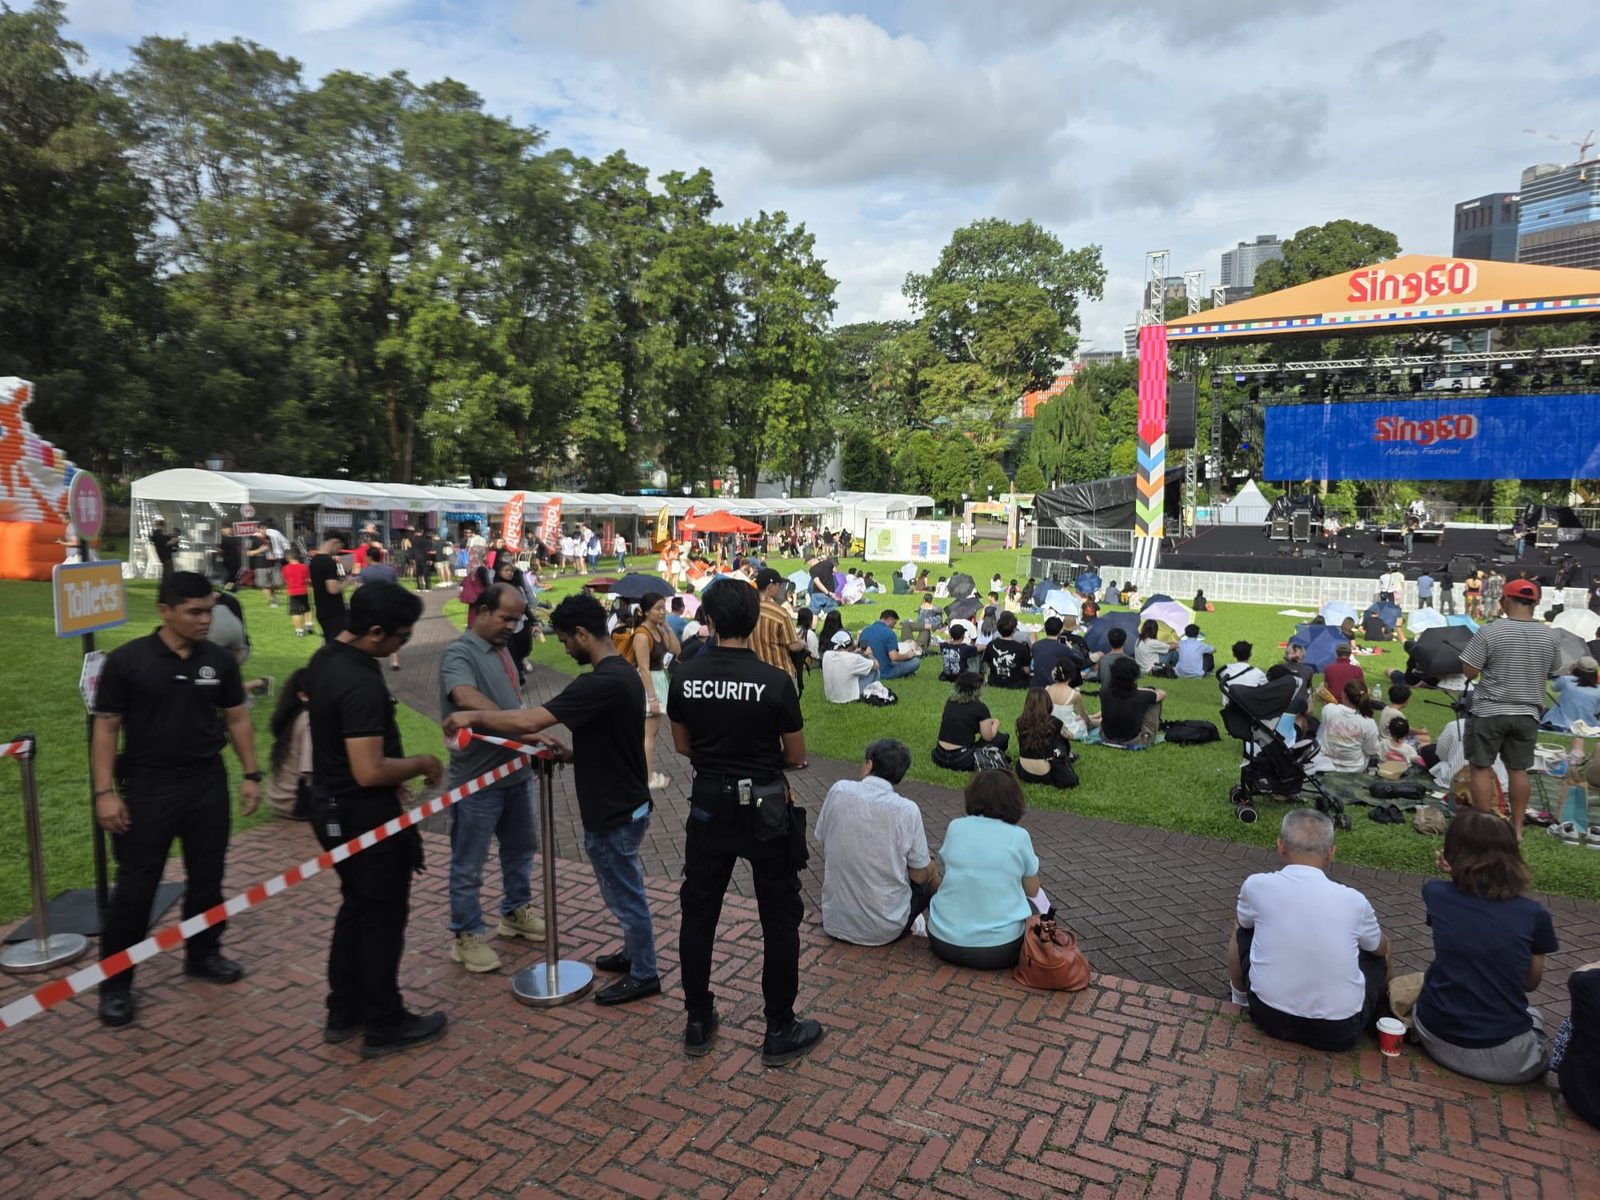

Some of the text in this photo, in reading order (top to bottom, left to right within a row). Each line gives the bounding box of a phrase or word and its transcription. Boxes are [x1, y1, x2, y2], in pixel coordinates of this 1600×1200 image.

[1347, 263, 1476, 304] Sing60
[1373, 414, 1477, 445] Sing60
[1385, 446, 1463, 456] Music Festival
[505, 501, 525, 548] APEROL
[545, 504, 561, 549] APEROL
[64, 579, 117, 618] Toilets
[683, 680, 766, 702] SECURITY
